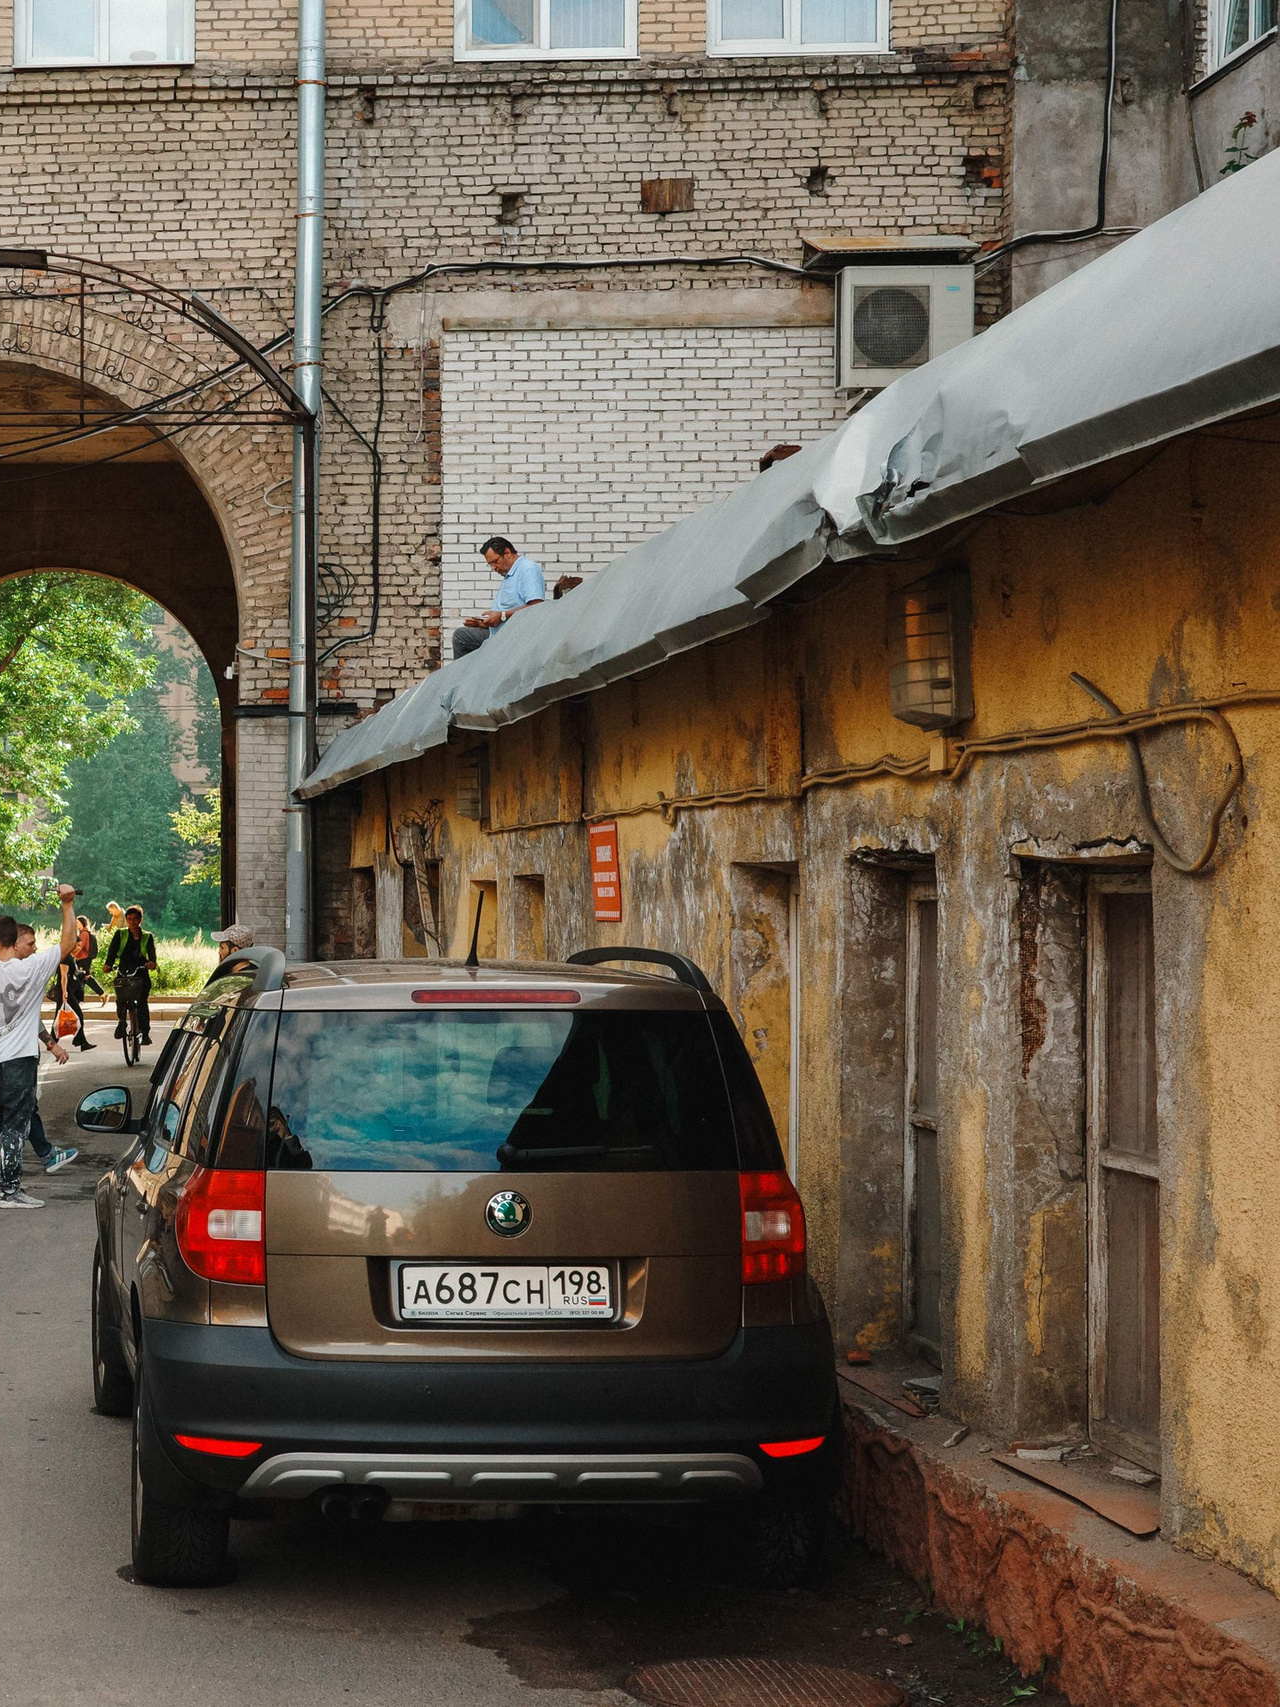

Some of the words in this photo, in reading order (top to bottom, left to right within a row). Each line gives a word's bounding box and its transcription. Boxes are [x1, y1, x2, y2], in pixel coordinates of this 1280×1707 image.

[413, 1272, 544, 1304] А687СН
[552, 1270, 602, 1295] 198
[563, 1296, 588, 1305] RUS
